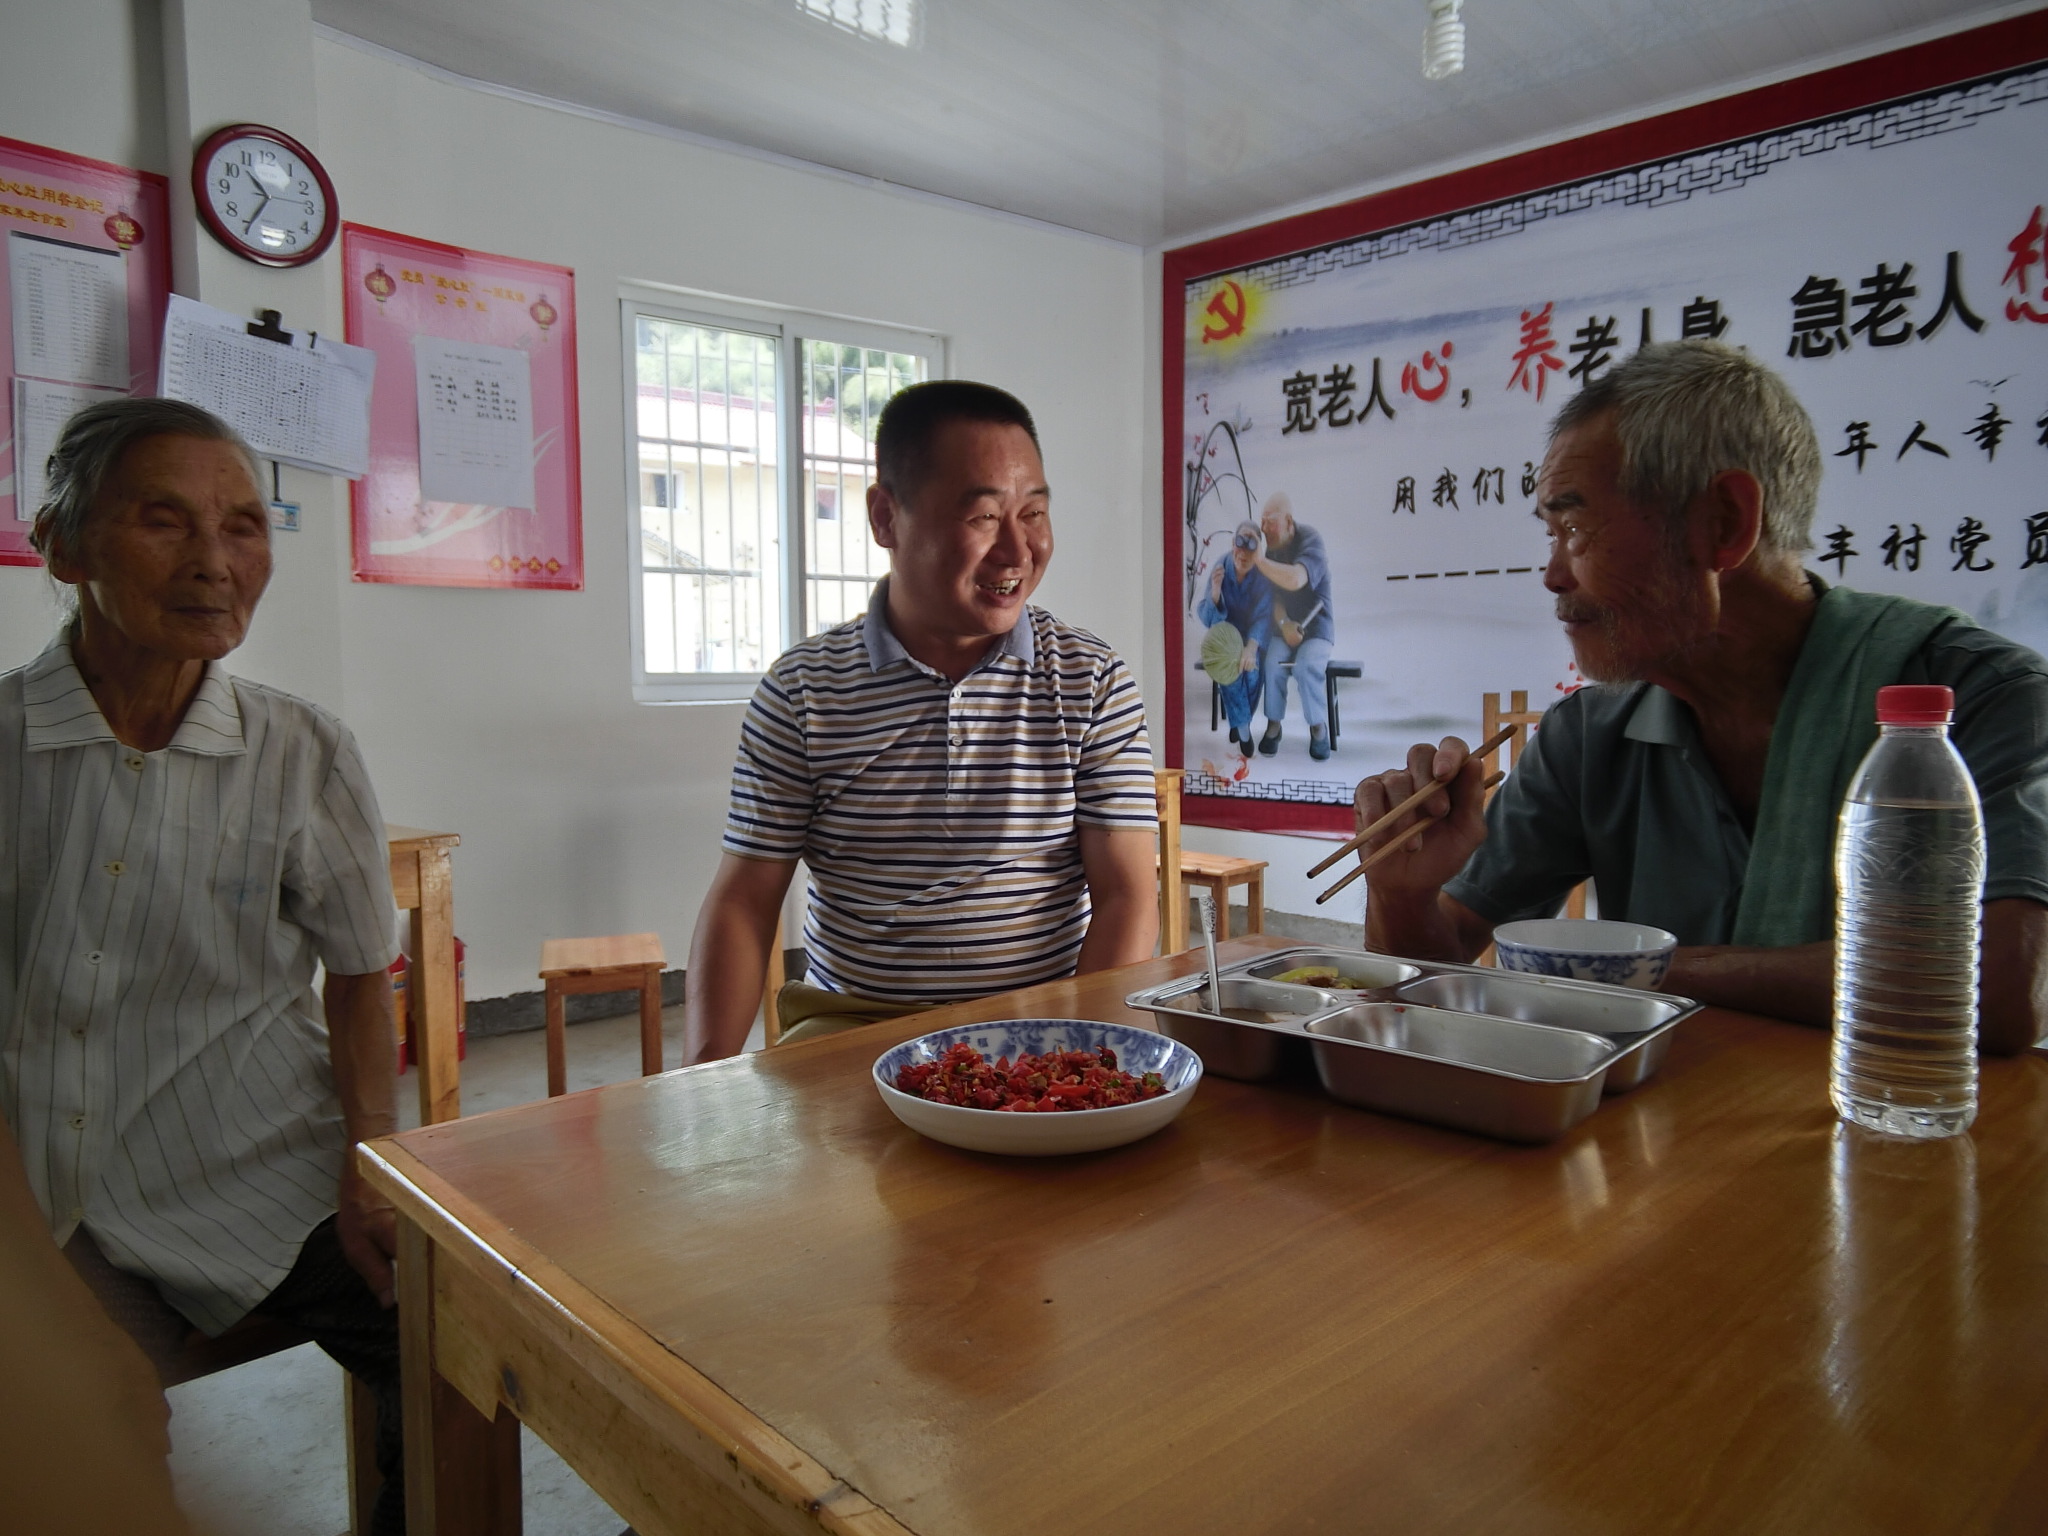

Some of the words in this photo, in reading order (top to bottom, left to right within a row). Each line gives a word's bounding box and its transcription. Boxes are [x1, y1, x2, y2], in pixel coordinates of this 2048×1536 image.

[241, 150, 252, 167] 11
[260, 150, 276, 167] 12
[225, 162, 240, 179] 10
[287, 163, 293, 178] 1
[219, 178, 231, 195] 9
[299, 180, 309, 196] 2
[226, 201, 238, 218] 8
[304, 200, 315, 216] 3
[301, 221, 310, 235] 4
[286, 229, 296, 245] 5
[1833, 403, 2048, 474] 年人幸
